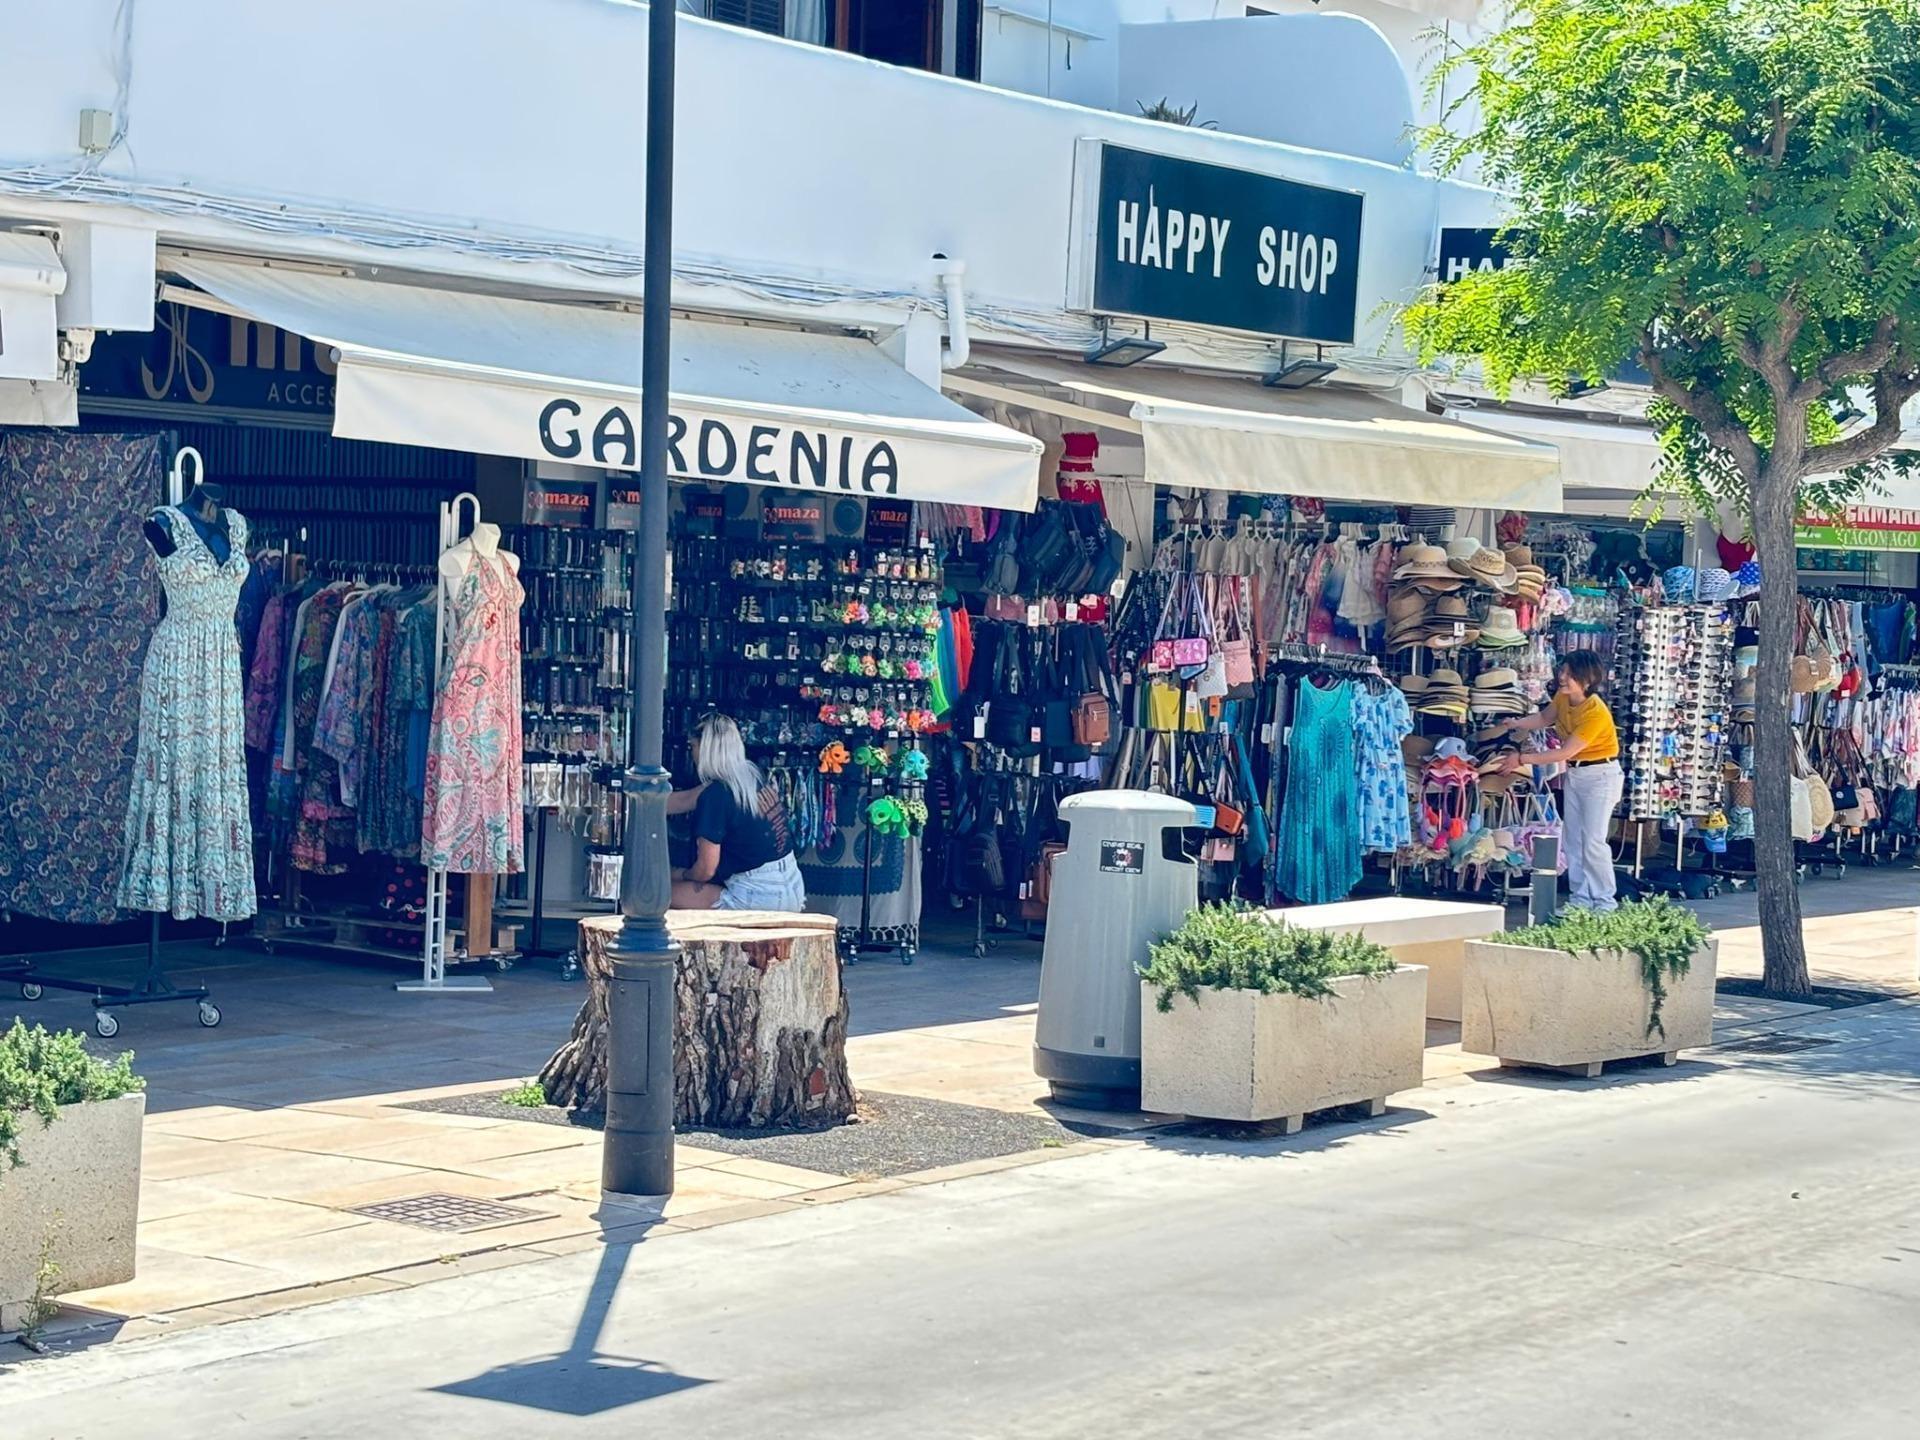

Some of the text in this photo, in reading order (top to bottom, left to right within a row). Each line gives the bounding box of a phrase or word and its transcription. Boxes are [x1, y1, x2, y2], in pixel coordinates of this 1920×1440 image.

[1117, 200, 1338, 294] HAPPY SHOP
[539, 398, 899, 495] GARDENIA
[544, 492, 590, 506] maza
[778, 507, 820, 519] maza
